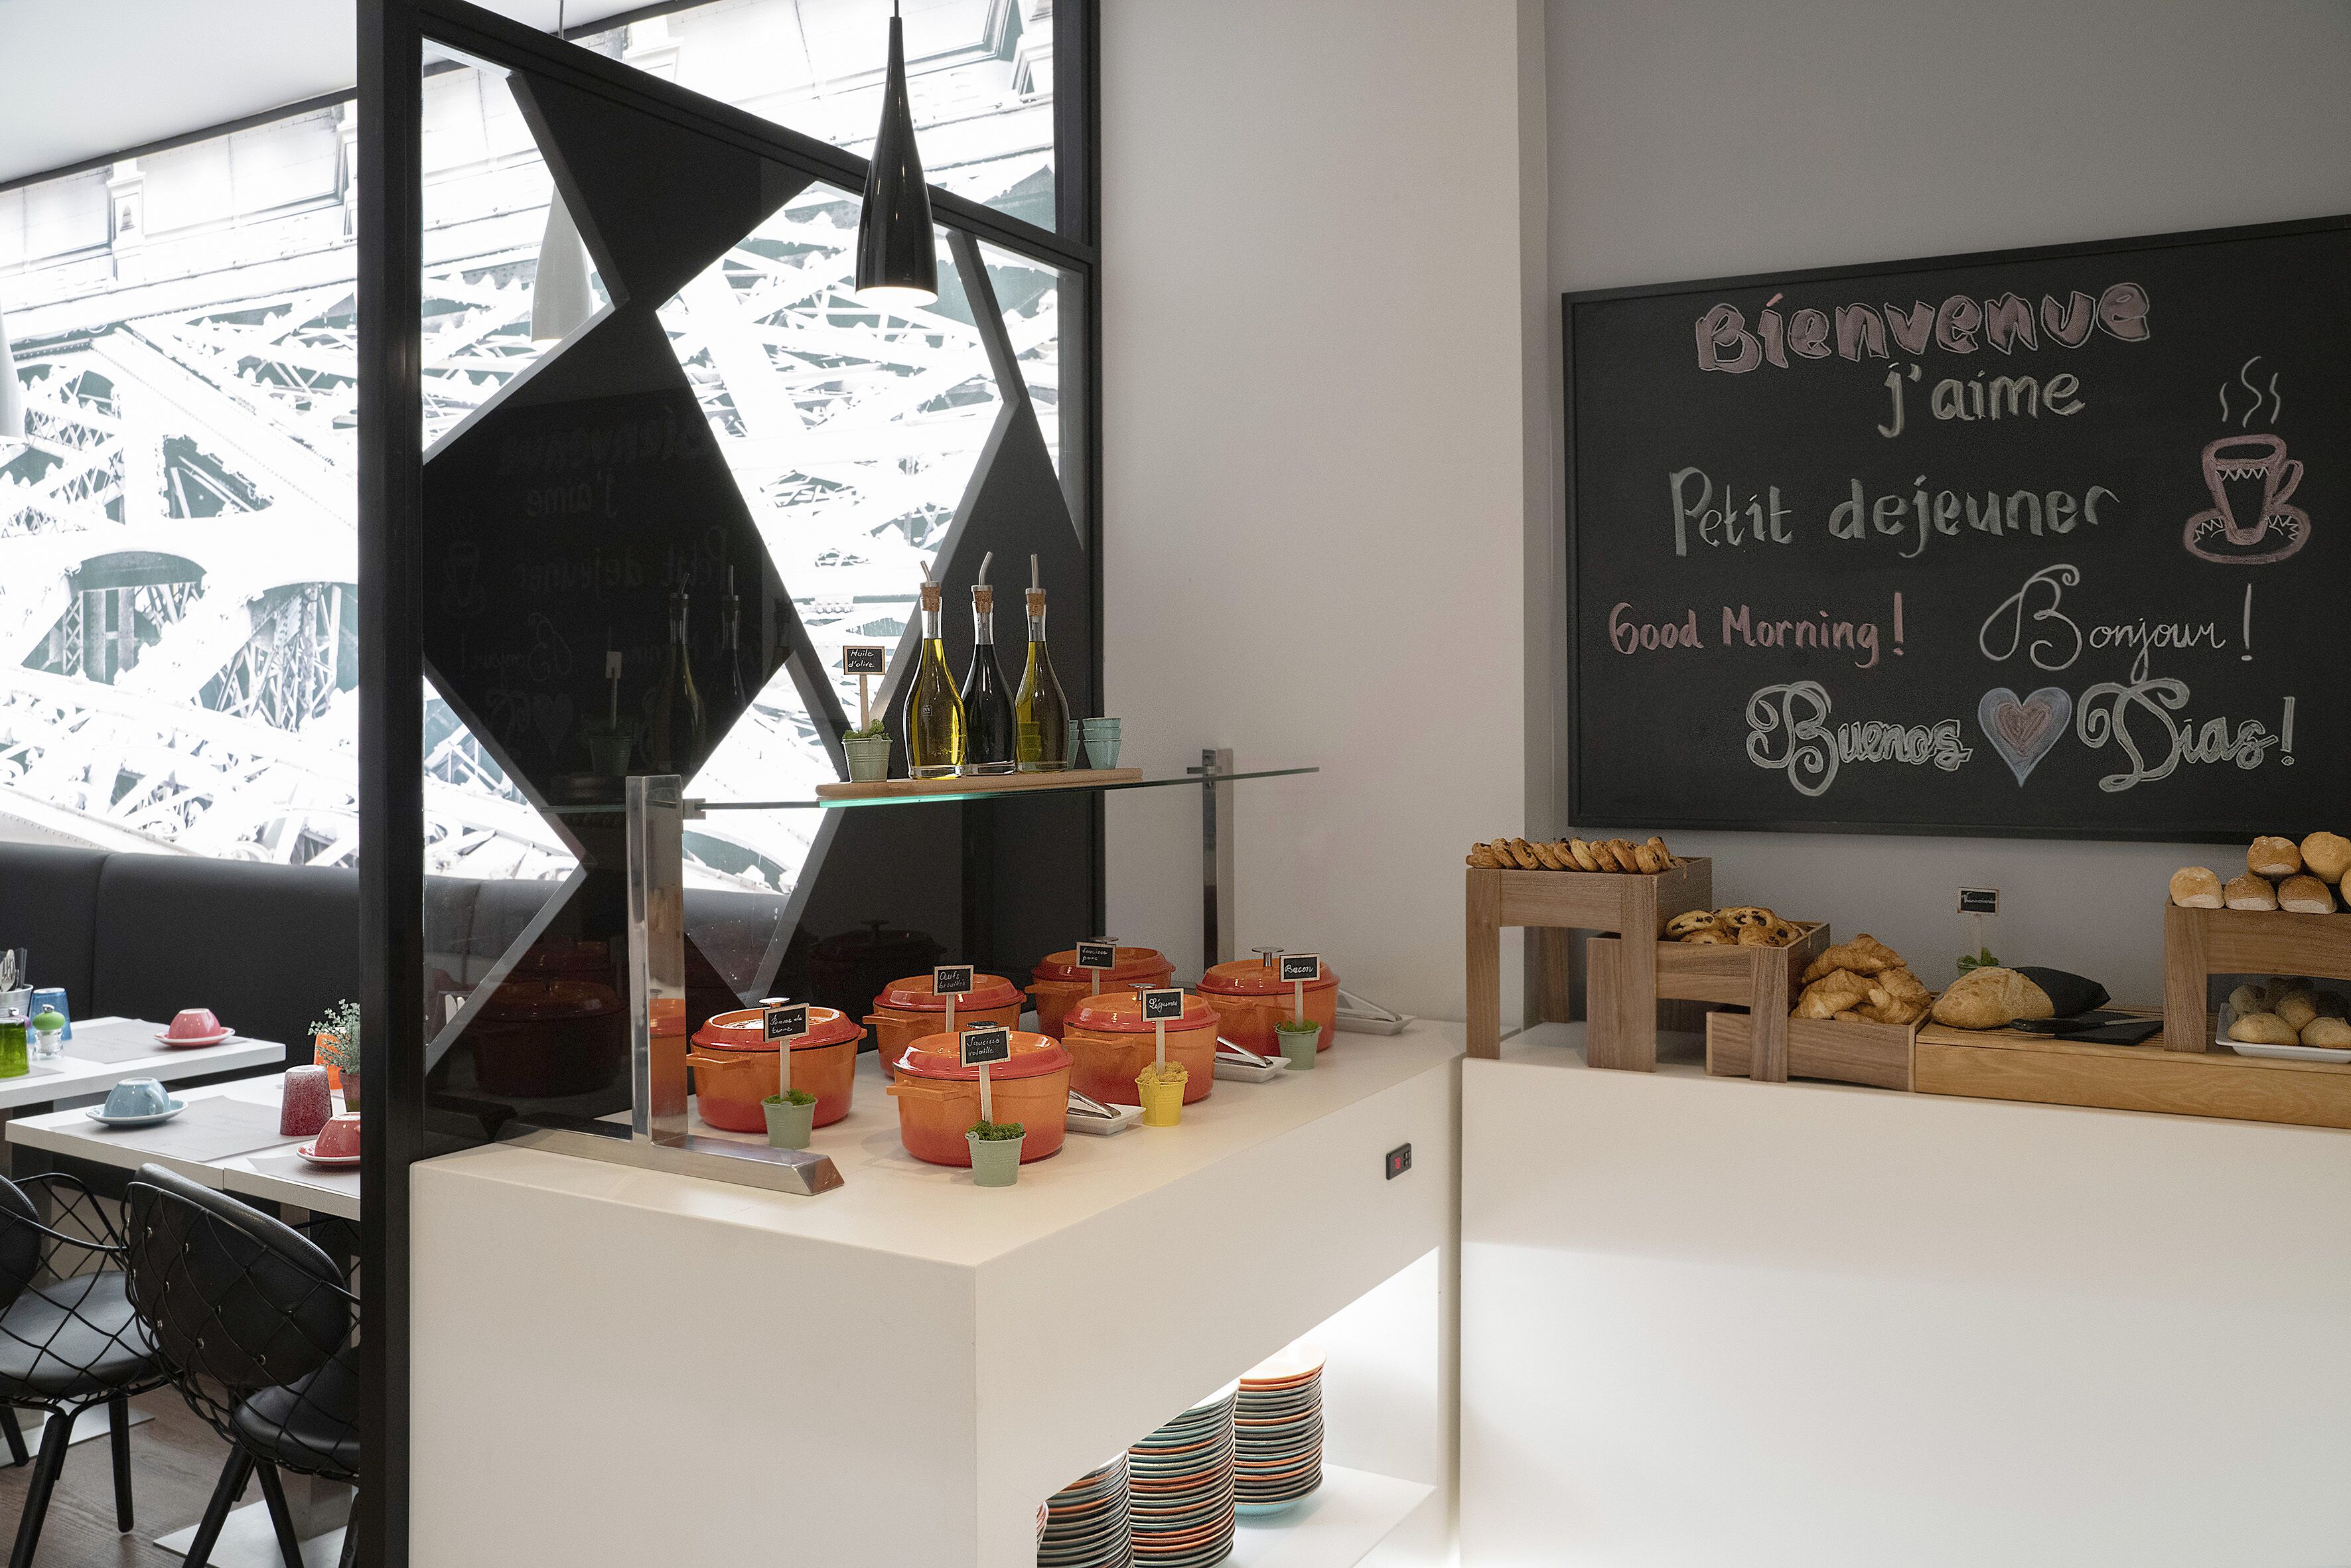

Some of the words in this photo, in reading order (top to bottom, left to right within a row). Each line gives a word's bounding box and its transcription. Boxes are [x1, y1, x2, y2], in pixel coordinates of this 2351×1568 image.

[1695, 283, 2150, 373] Bienvenue
[1877, 362, 2085, 438] j'aime
[1670, 467, 1793, 556] Petit
[1828, 476, 2120, 558] dejeuner
[1608, 603, 1703, 654] Good
[1745, 679, 1973, 796] Buenos
[1285, 963, 1314, 973] Bacon
[770, 1014, 792, 1026] Pomme
[1149, 997, 1178, 1013] Légumes
